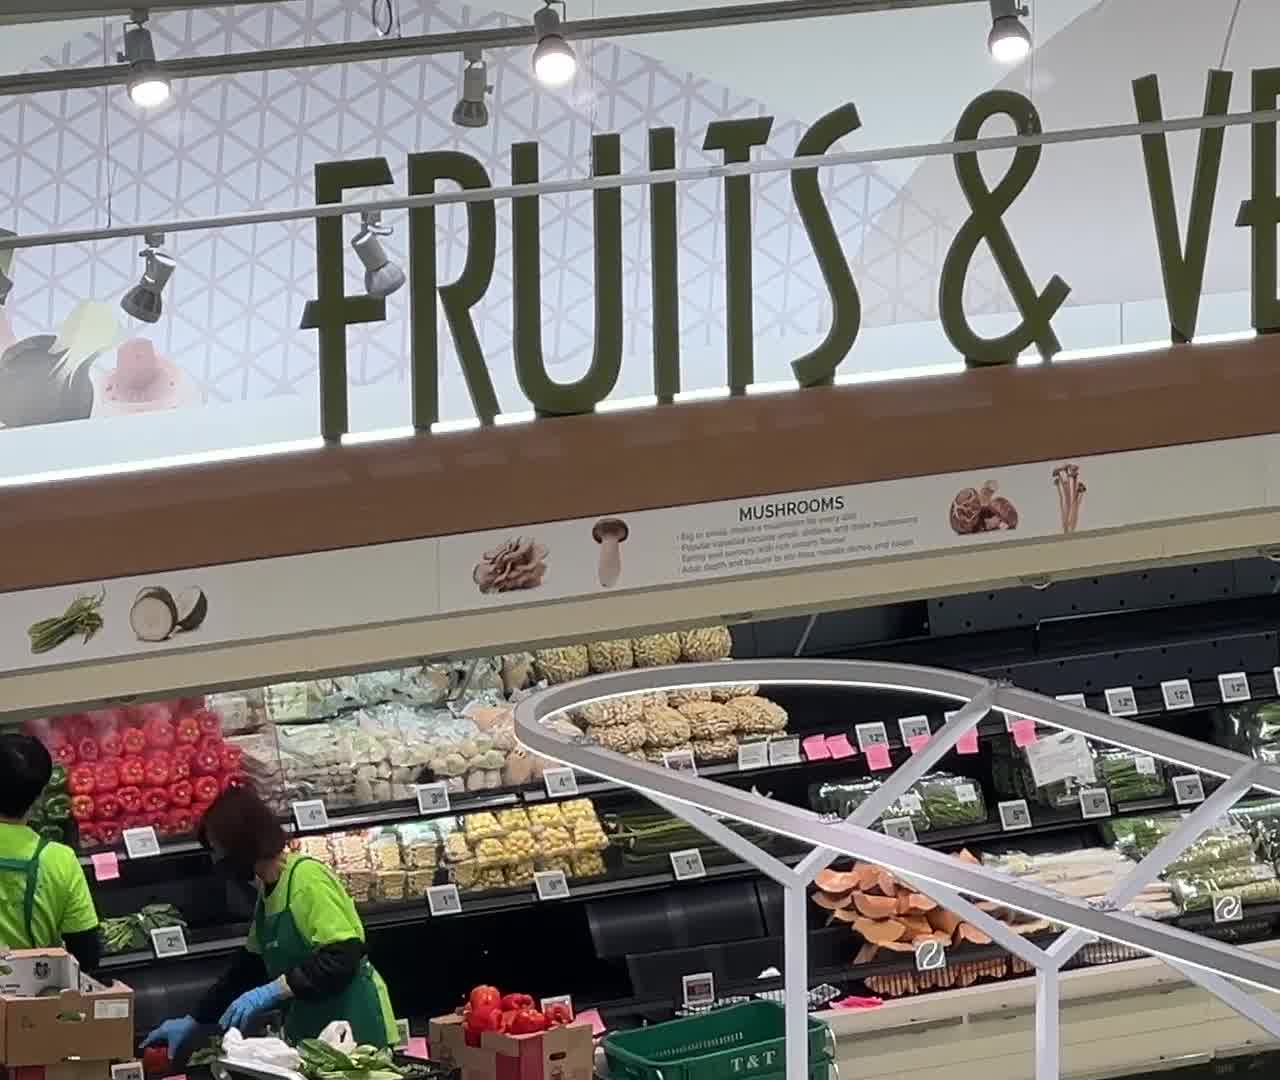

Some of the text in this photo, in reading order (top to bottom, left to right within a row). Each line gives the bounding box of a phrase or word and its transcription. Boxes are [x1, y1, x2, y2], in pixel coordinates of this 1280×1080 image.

[299, 101, 862, 446] FRUITS
[938, 89, 1072, 367] &
[738, 495, 845, 521] MUSHROOMS
